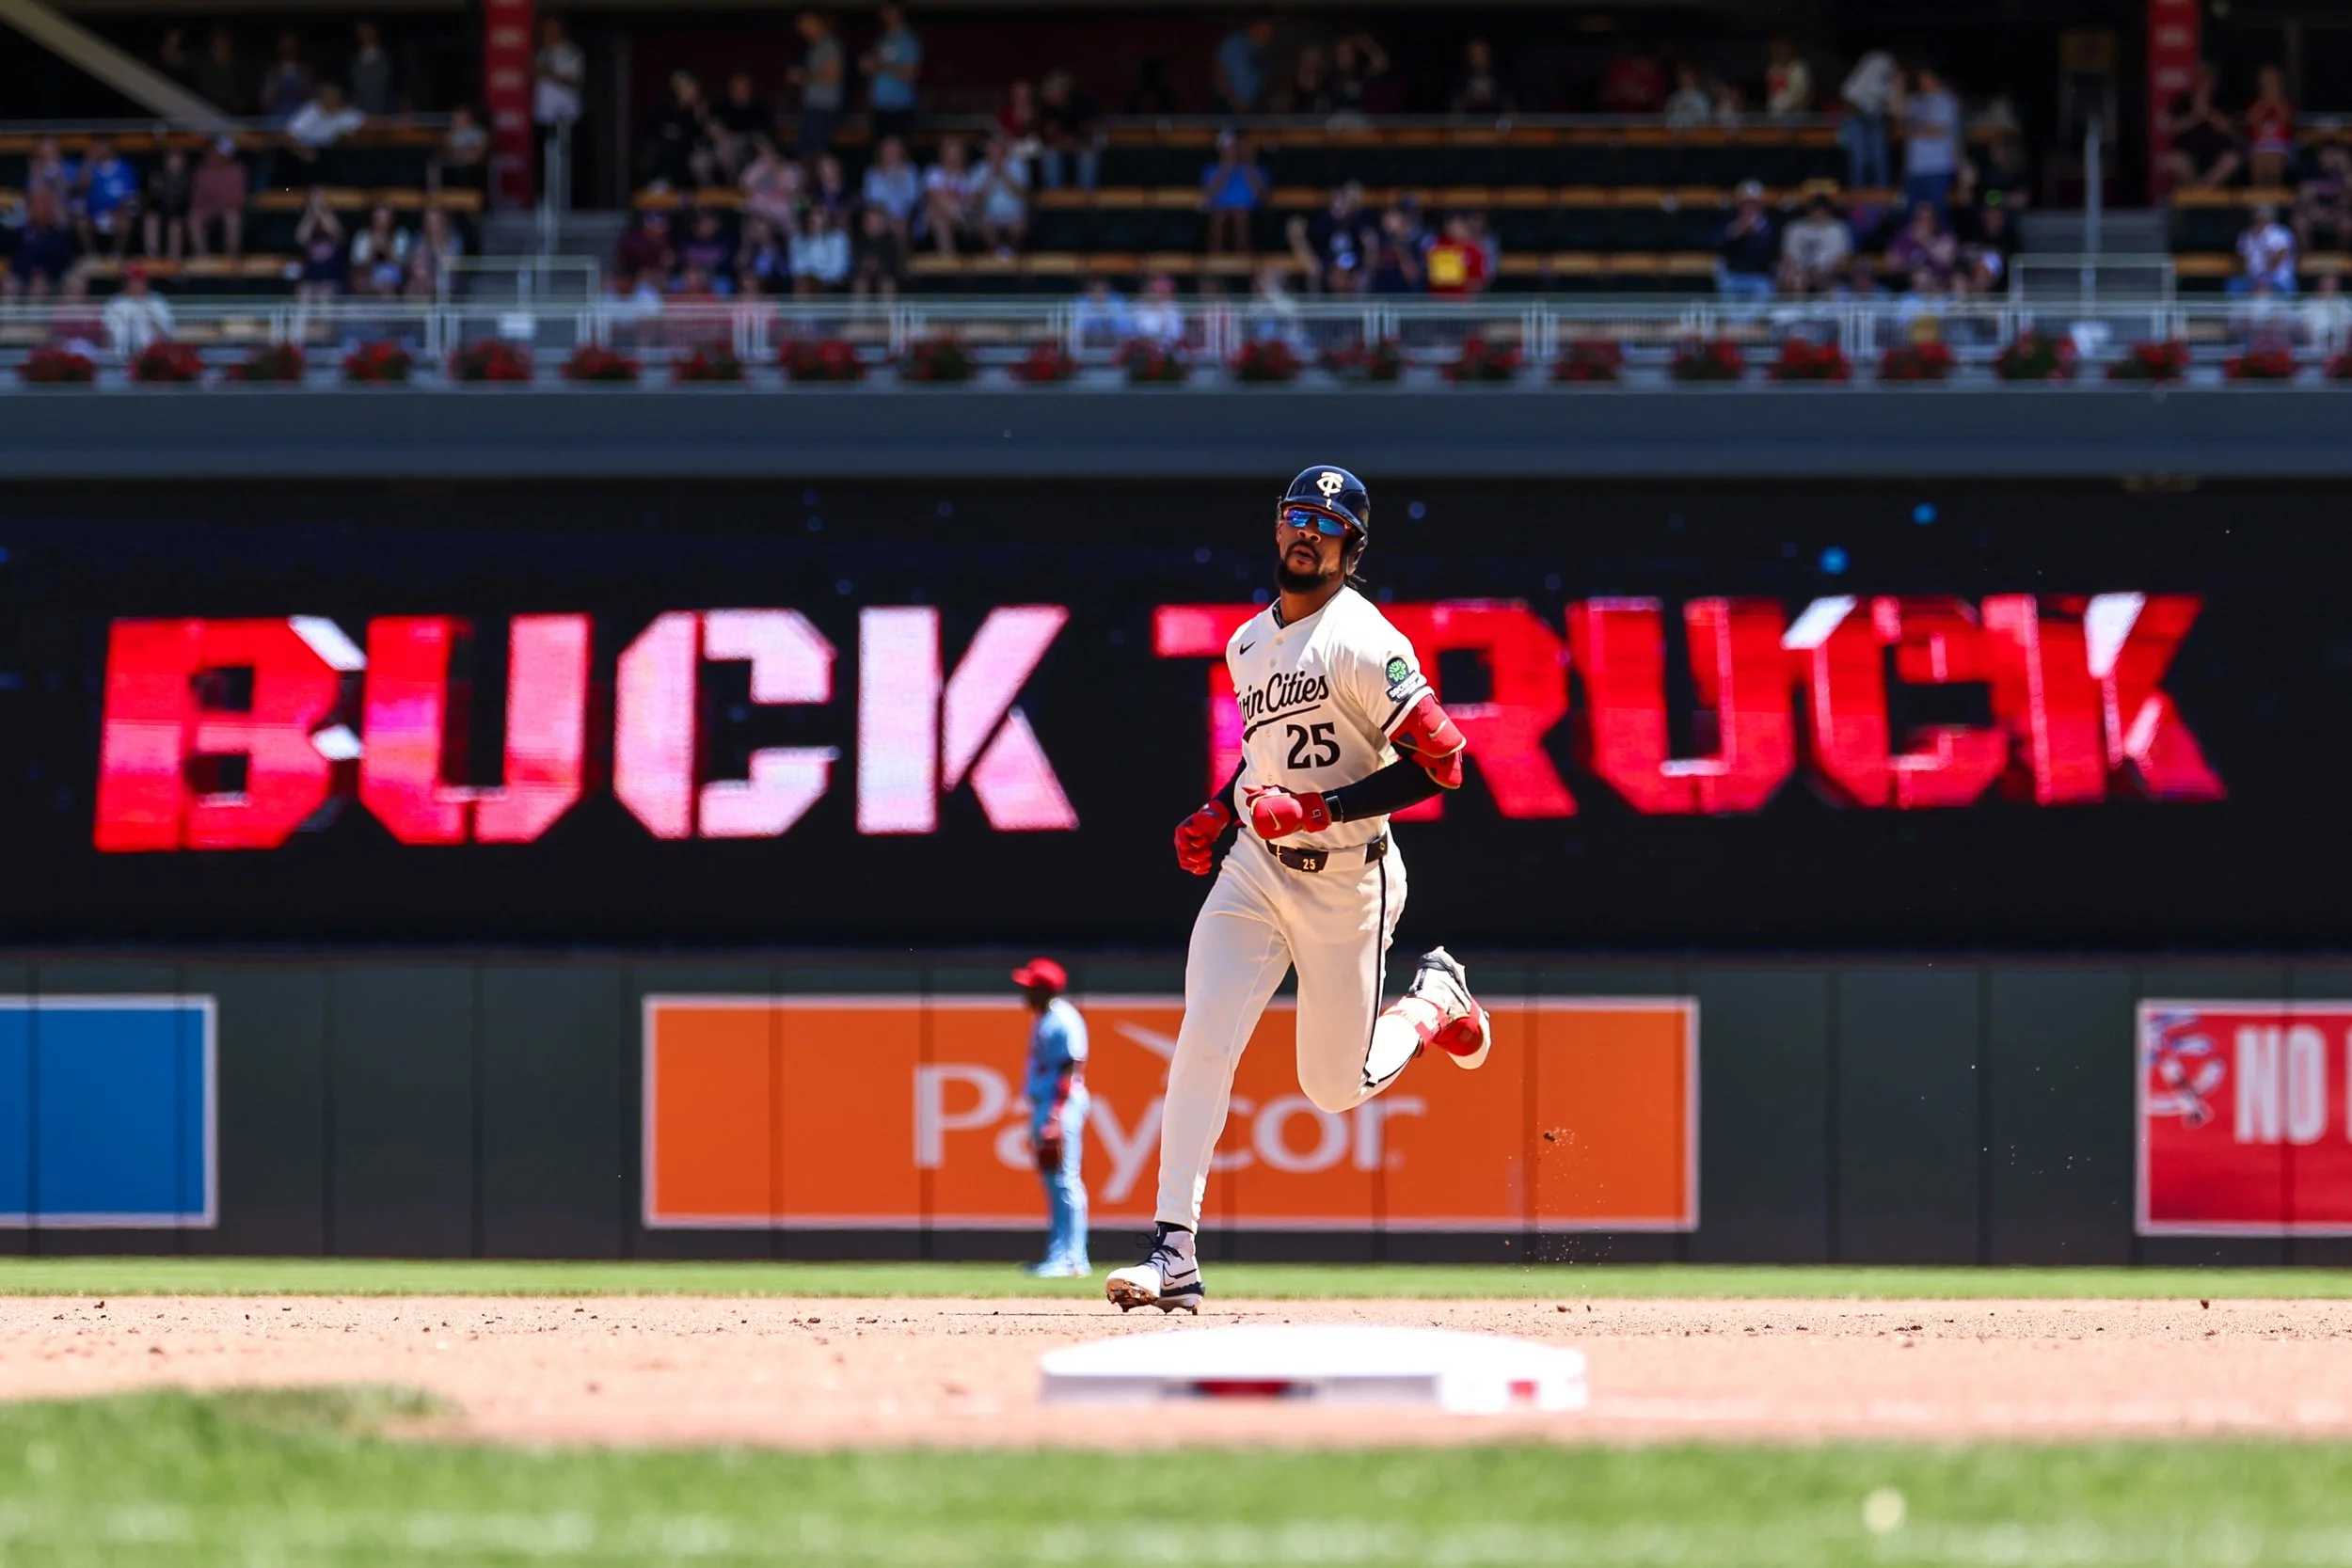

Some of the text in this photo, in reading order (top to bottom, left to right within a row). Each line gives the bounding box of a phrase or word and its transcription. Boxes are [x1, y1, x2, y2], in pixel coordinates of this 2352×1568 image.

[1236, 671, 1329, 727] win Cities
[93, 604, 1079, 853] BUCK
[1286, 721, 1341, 769] 25
[1301, 858, 1316, 870] 25
[2234, 1024, 2328, 1145] NO
